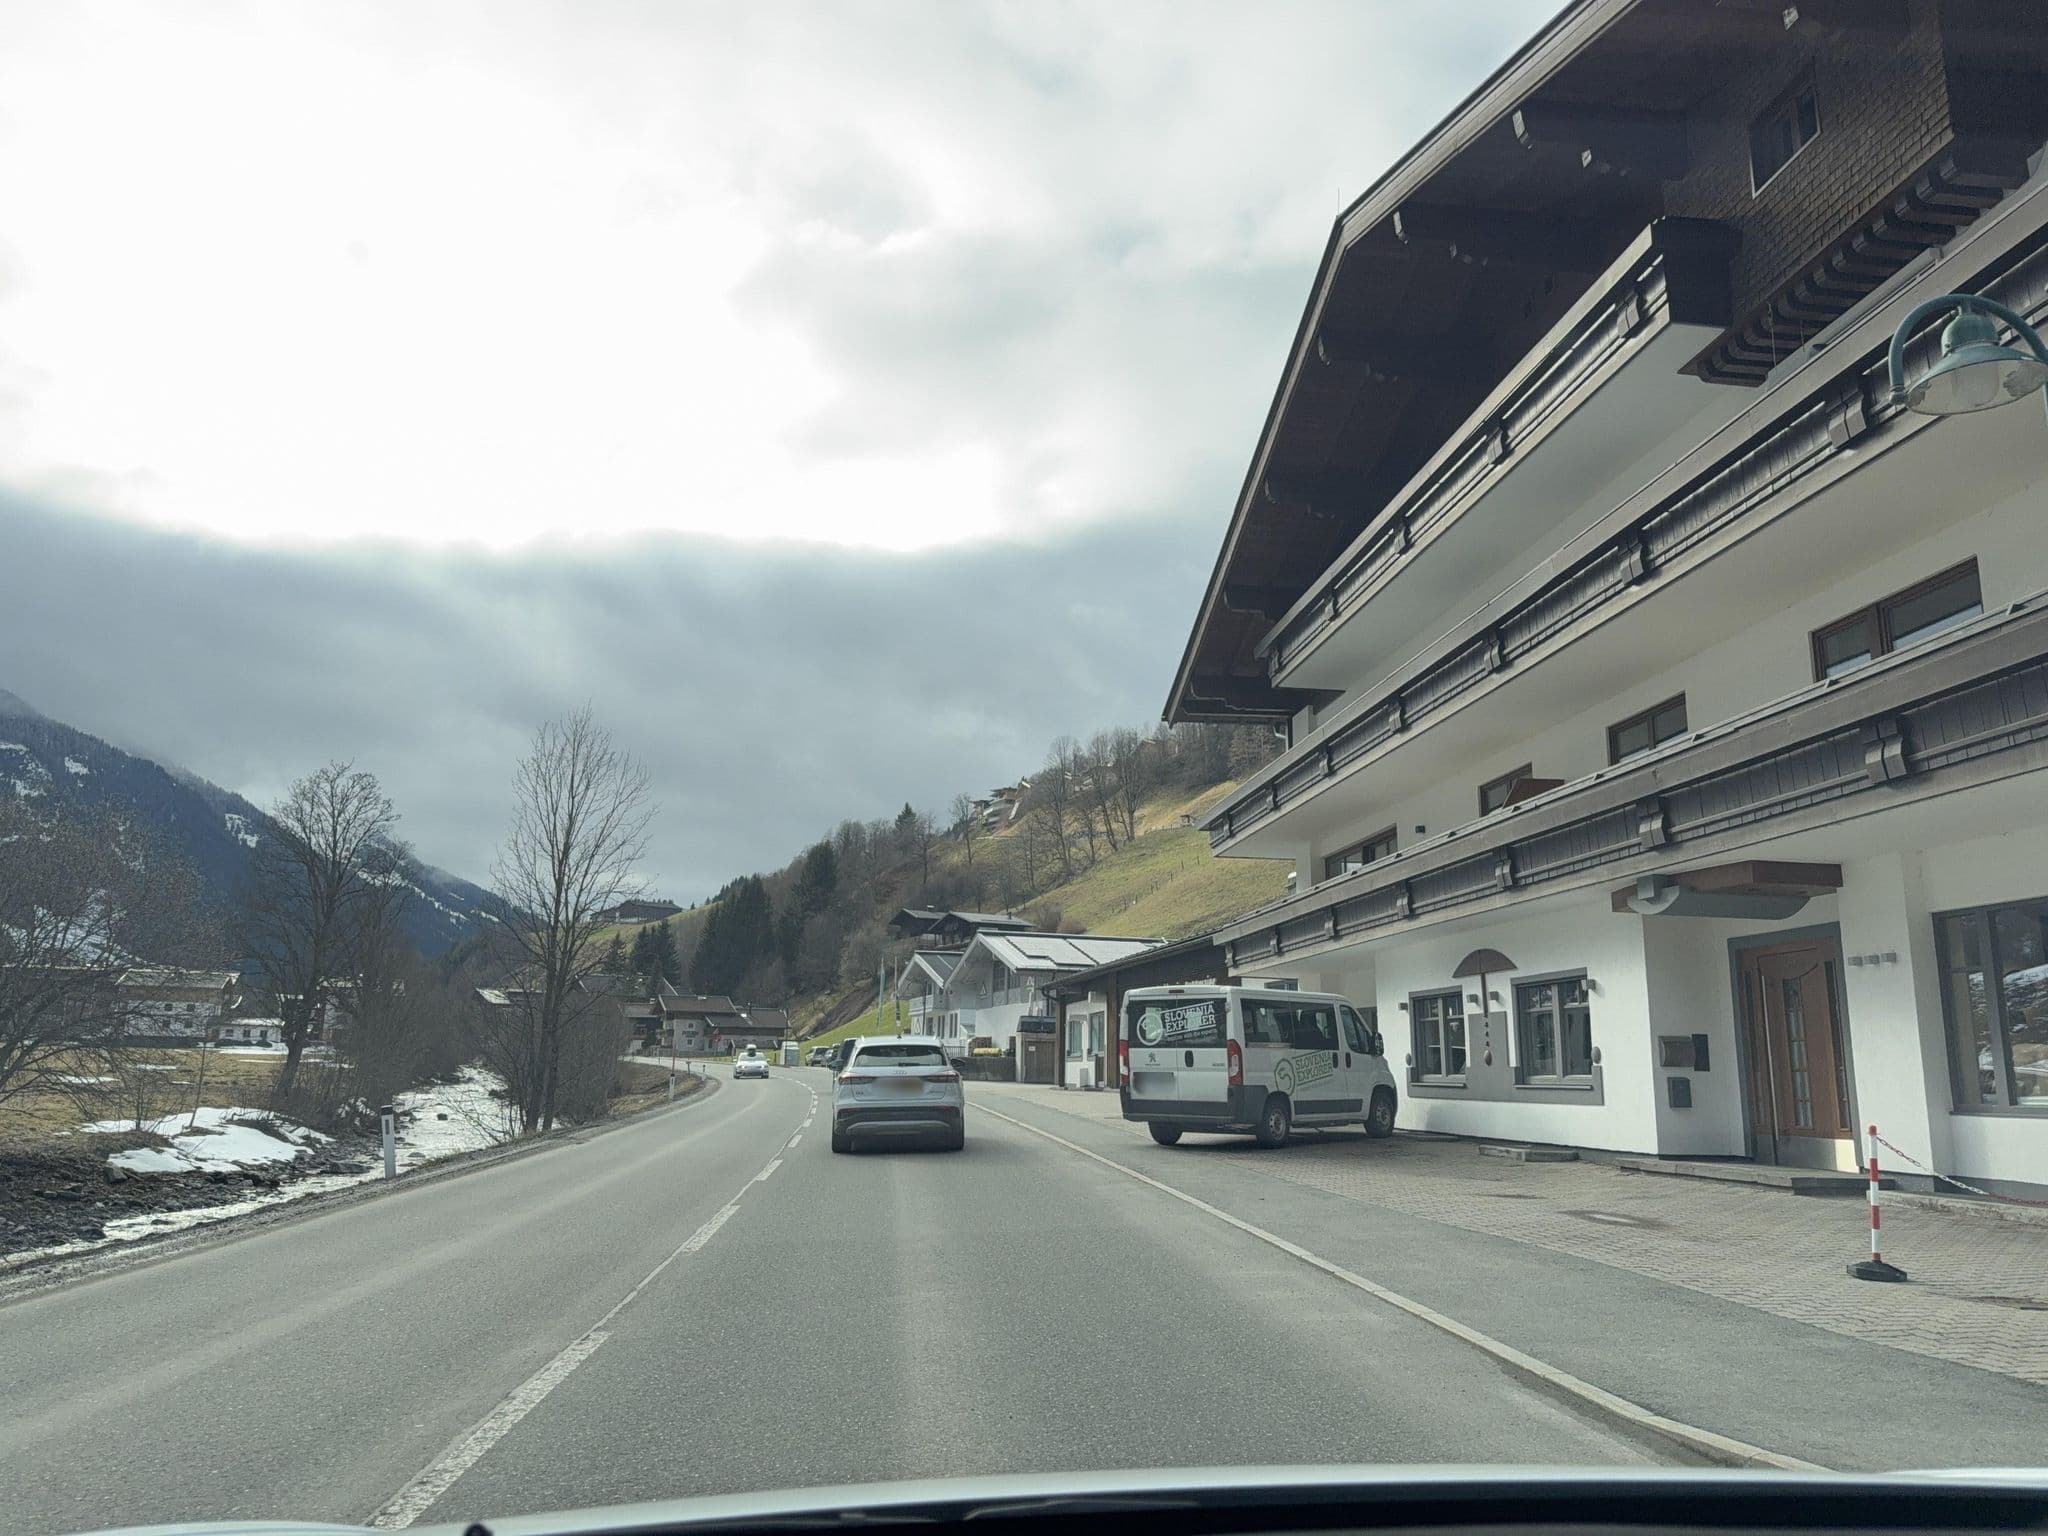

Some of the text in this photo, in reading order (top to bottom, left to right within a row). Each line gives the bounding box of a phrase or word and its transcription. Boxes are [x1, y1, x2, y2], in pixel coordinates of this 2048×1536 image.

[1164, 1004, 1215, 1022] SLOVENIA
[1295, 1051, 1332, 1070] SLOVENIA
[1296, 1063, 1333, 1082] EXPLORER
